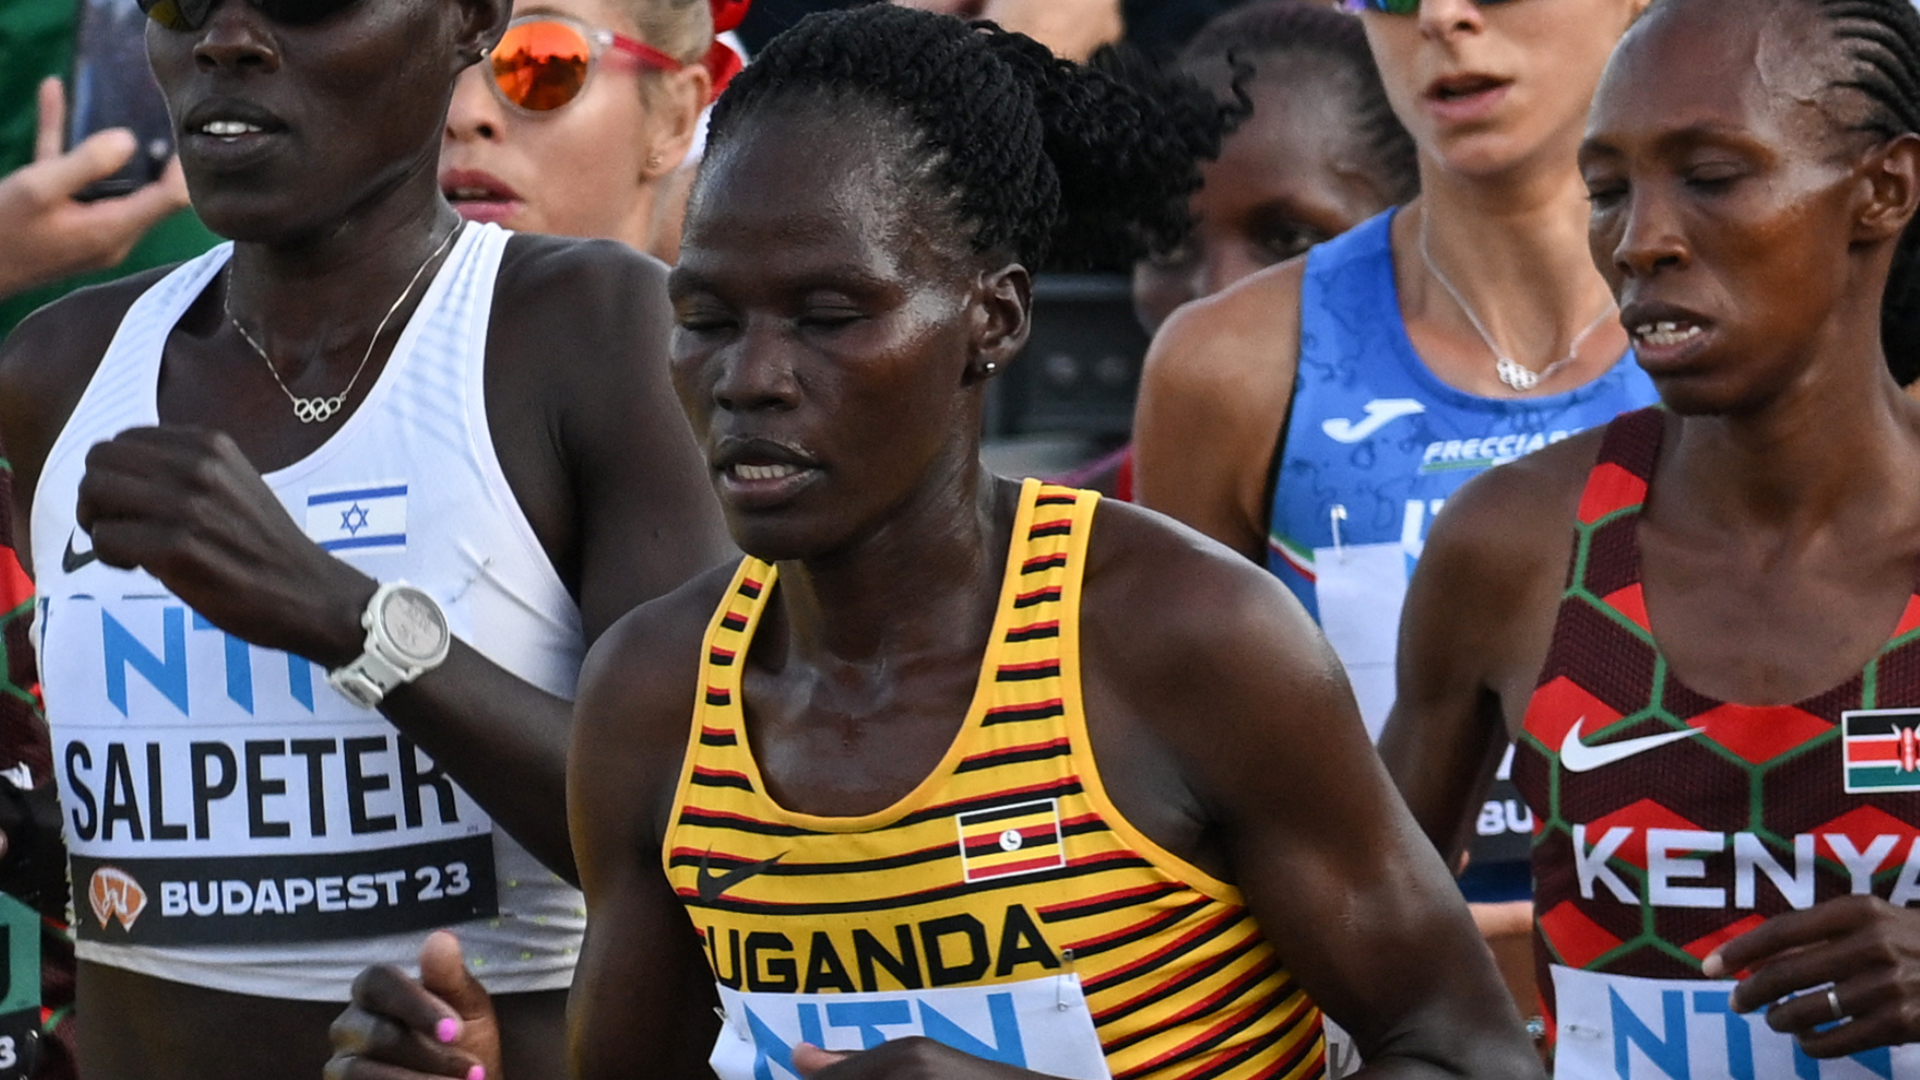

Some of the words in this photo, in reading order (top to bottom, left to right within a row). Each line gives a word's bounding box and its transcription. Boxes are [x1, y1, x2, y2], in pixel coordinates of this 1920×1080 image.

[65, 734, 460, 842] SALPETER
[161, 871, 405, 917] BUDAPEST
[416, 862, 471, 901] 23
[706, 903, 1062, 994] UGANDA
